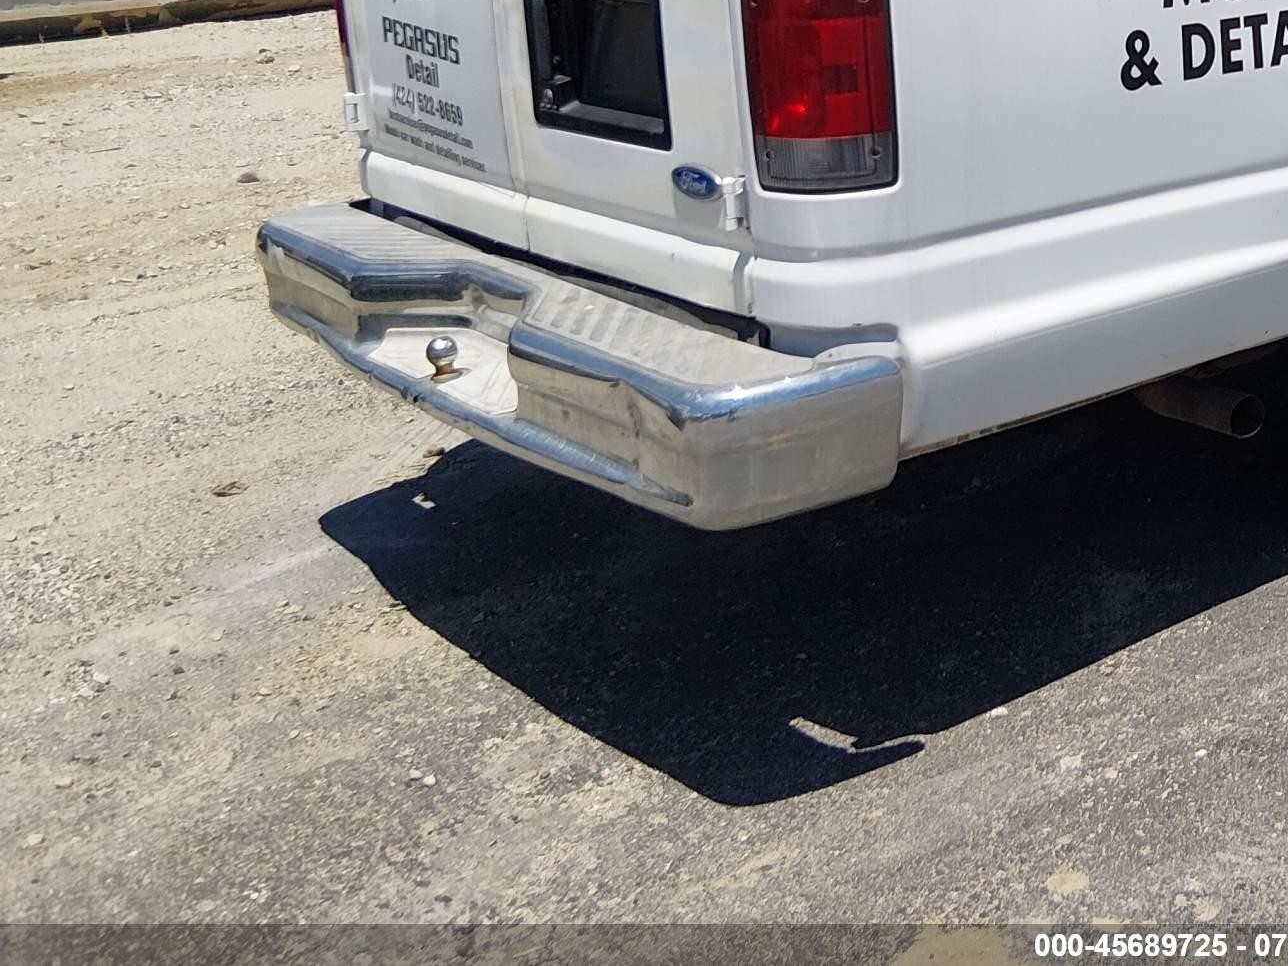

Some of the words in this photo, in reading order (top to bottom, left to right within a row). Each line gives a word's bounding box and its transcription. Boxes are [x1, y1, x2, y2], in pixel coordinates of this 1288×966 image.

[382, 16, 461, 65] PEGASUS
[1120, 29, 1162, 91] &
[406, 54, 440, 89] Detail
[393, 82, 415, 113] (424)
[417, 92, 464, 127] 522-8659
